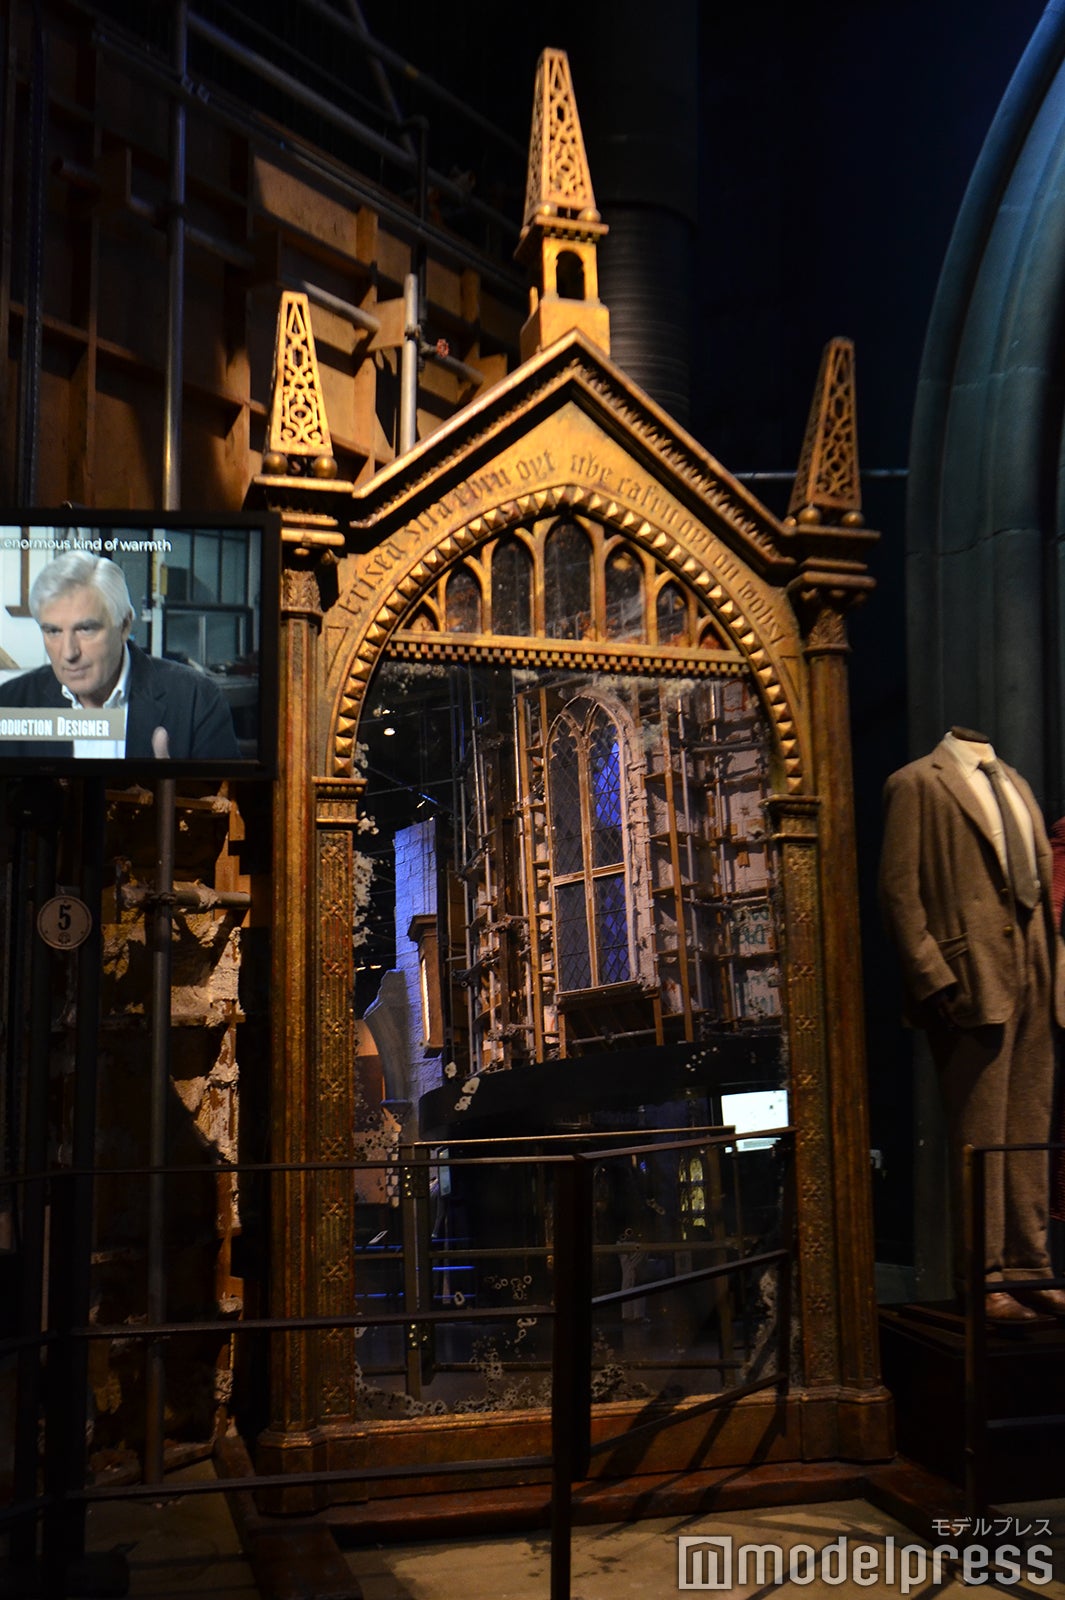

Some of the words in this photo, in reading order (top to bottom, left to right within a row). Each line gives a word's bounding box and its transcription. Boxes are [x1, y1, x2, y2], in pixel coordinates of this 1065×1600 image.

[3, 539, 71, 551] enormous
[73, 537, 102, 551] kind
[104, 537, 119, 551] of
[120, 538, 173, 552] warmth
[0, 718, 53, 737] ODUCTION
[57, 716, 110, 737] DESIGNER
[58, 904, 71, 930] 5
